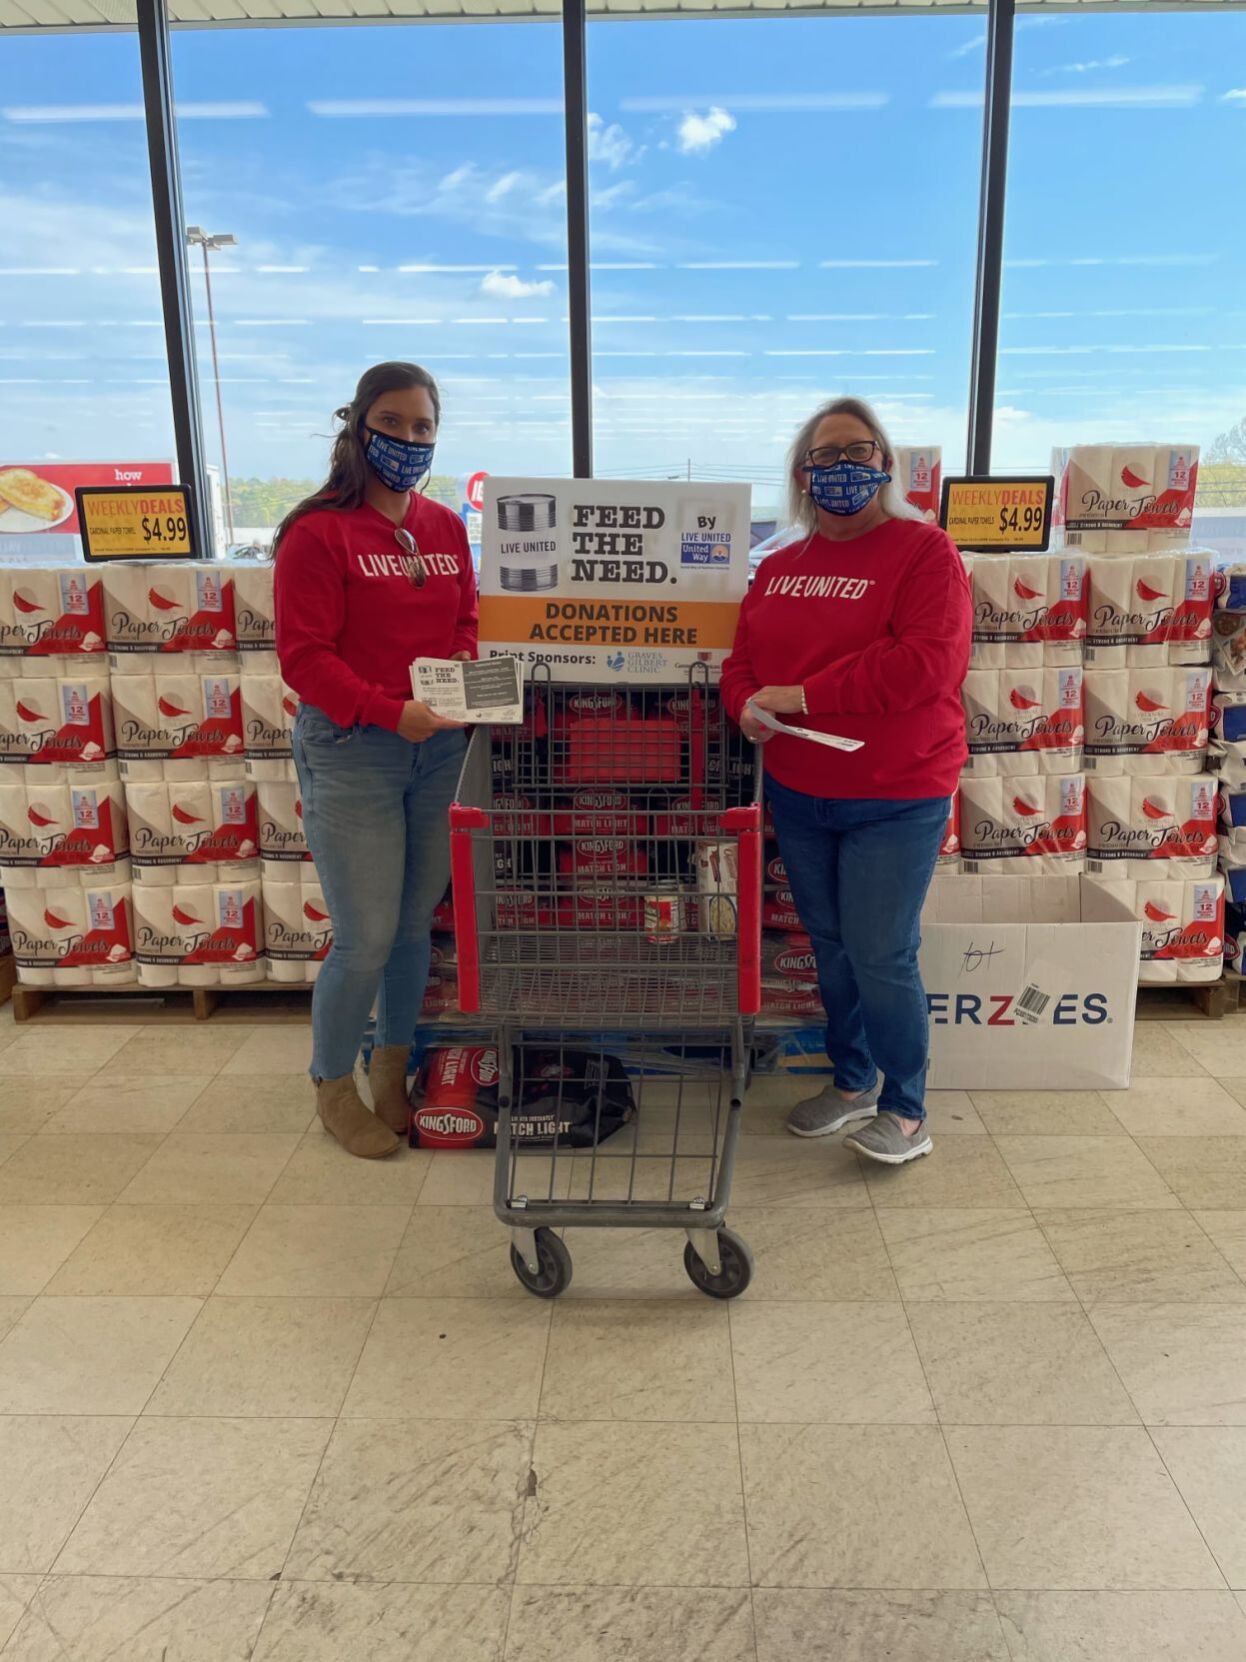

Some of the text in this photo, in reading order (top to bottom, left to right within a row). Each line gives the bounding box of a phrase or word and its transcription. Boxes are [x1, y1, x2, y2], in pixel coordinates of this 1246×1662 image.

[114, 469, 142, 480] how
[916, 472, 928, 480] 12
[1082, 490, 1130, 517] Paper
[574, 505, 665, 530] FEED
[697, 516, 716, 530] By
[999, 504, 1042, 534] $4.99
[142, 515, 186, 544] $4.99
[682, 532, 732, 542] LIVE UNITED
[500, 541, 556, 554] LIVE UNITED
[572, 532, 643, 556] THE
[682, 545, 709, 553] United
[692, 554, 709, 563] Way
[570, 559, 677, 584] NEED.
[204, 592, 216, 600] 12
[546, 603, 678, 622] DONATIONS
[975, 602, 1023, 630] Paper
[1094, 606, 1145, 632] Paper
[112, 610, 162, 640] Paper
[530, 624, 698, 645] ACCEPTED HERE
[530, 651, 596, 666] Sponsors:
[628, 652, 663, 660] GRAVES
[628, 659, 668, 667] GILBERT
[628, 666, 661, 674] CLINIC
[1065, 690, 1076, 698] 12
[71, 706, 83, 714] 12
[122, 720, 172, 747] Paper
[970, 714, 1020, 740] Paper
[1095, 715, 1146, 740] Paper
[80, 810, 92, 818] 12
[228, 806, 240, 814] 12
[1198, 802, 1209, 810] 12
[136, 828, 186, 853] Paper
[974, 820, 1024, 844] Paper
[1101, 821, 1150, 847] Paper
[12, 930, 58, 956] Paper
[138, 926, 184, 952] Paper
[268, 922, 314, 948] Paper
[419, 1113, 478, 1134] KINGSFORD
